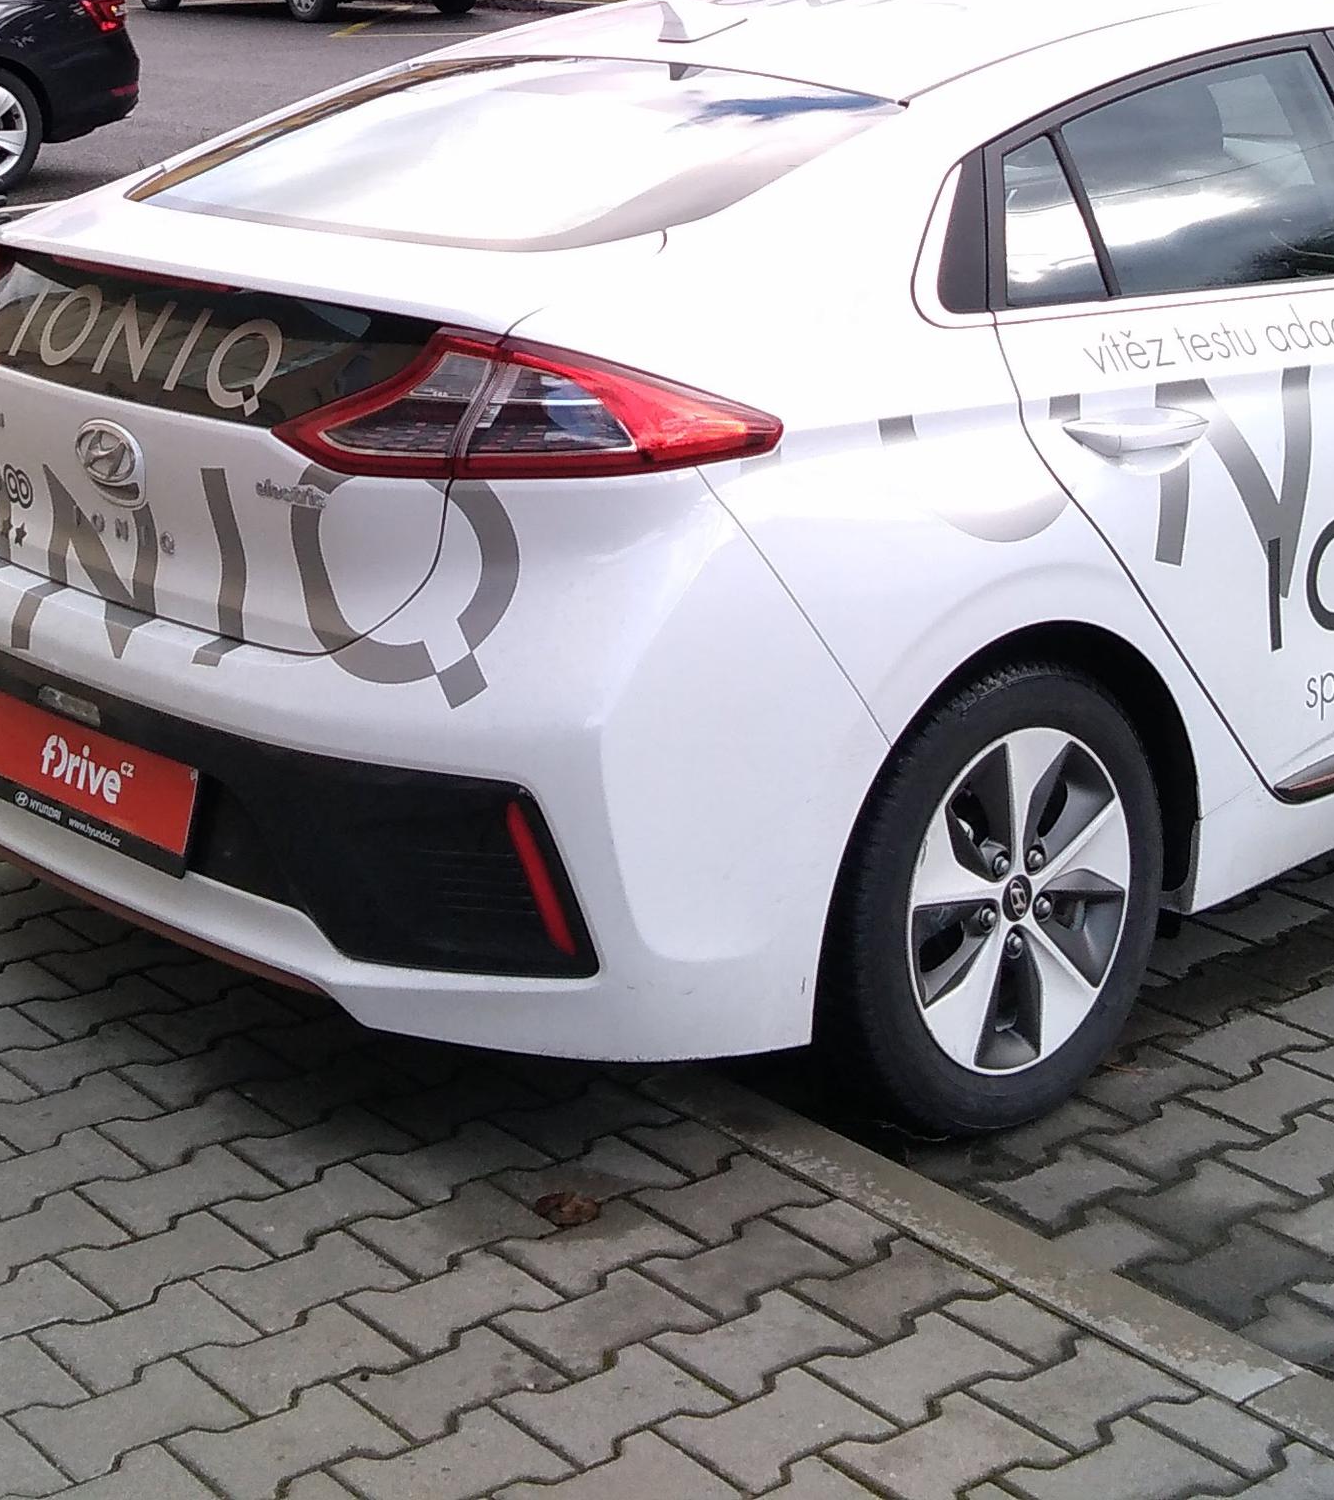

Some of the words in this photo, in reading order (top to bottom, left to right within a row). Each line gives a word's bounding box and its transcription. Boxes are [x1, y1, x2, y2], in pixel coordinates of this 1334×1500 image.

[7, 283, 284, 417] IONIQ
[1083, 330, 1176, 375] vítěz
[1174, 322, 1258, 363] testu
[28, 798, 62, 821] HYUNDAI
